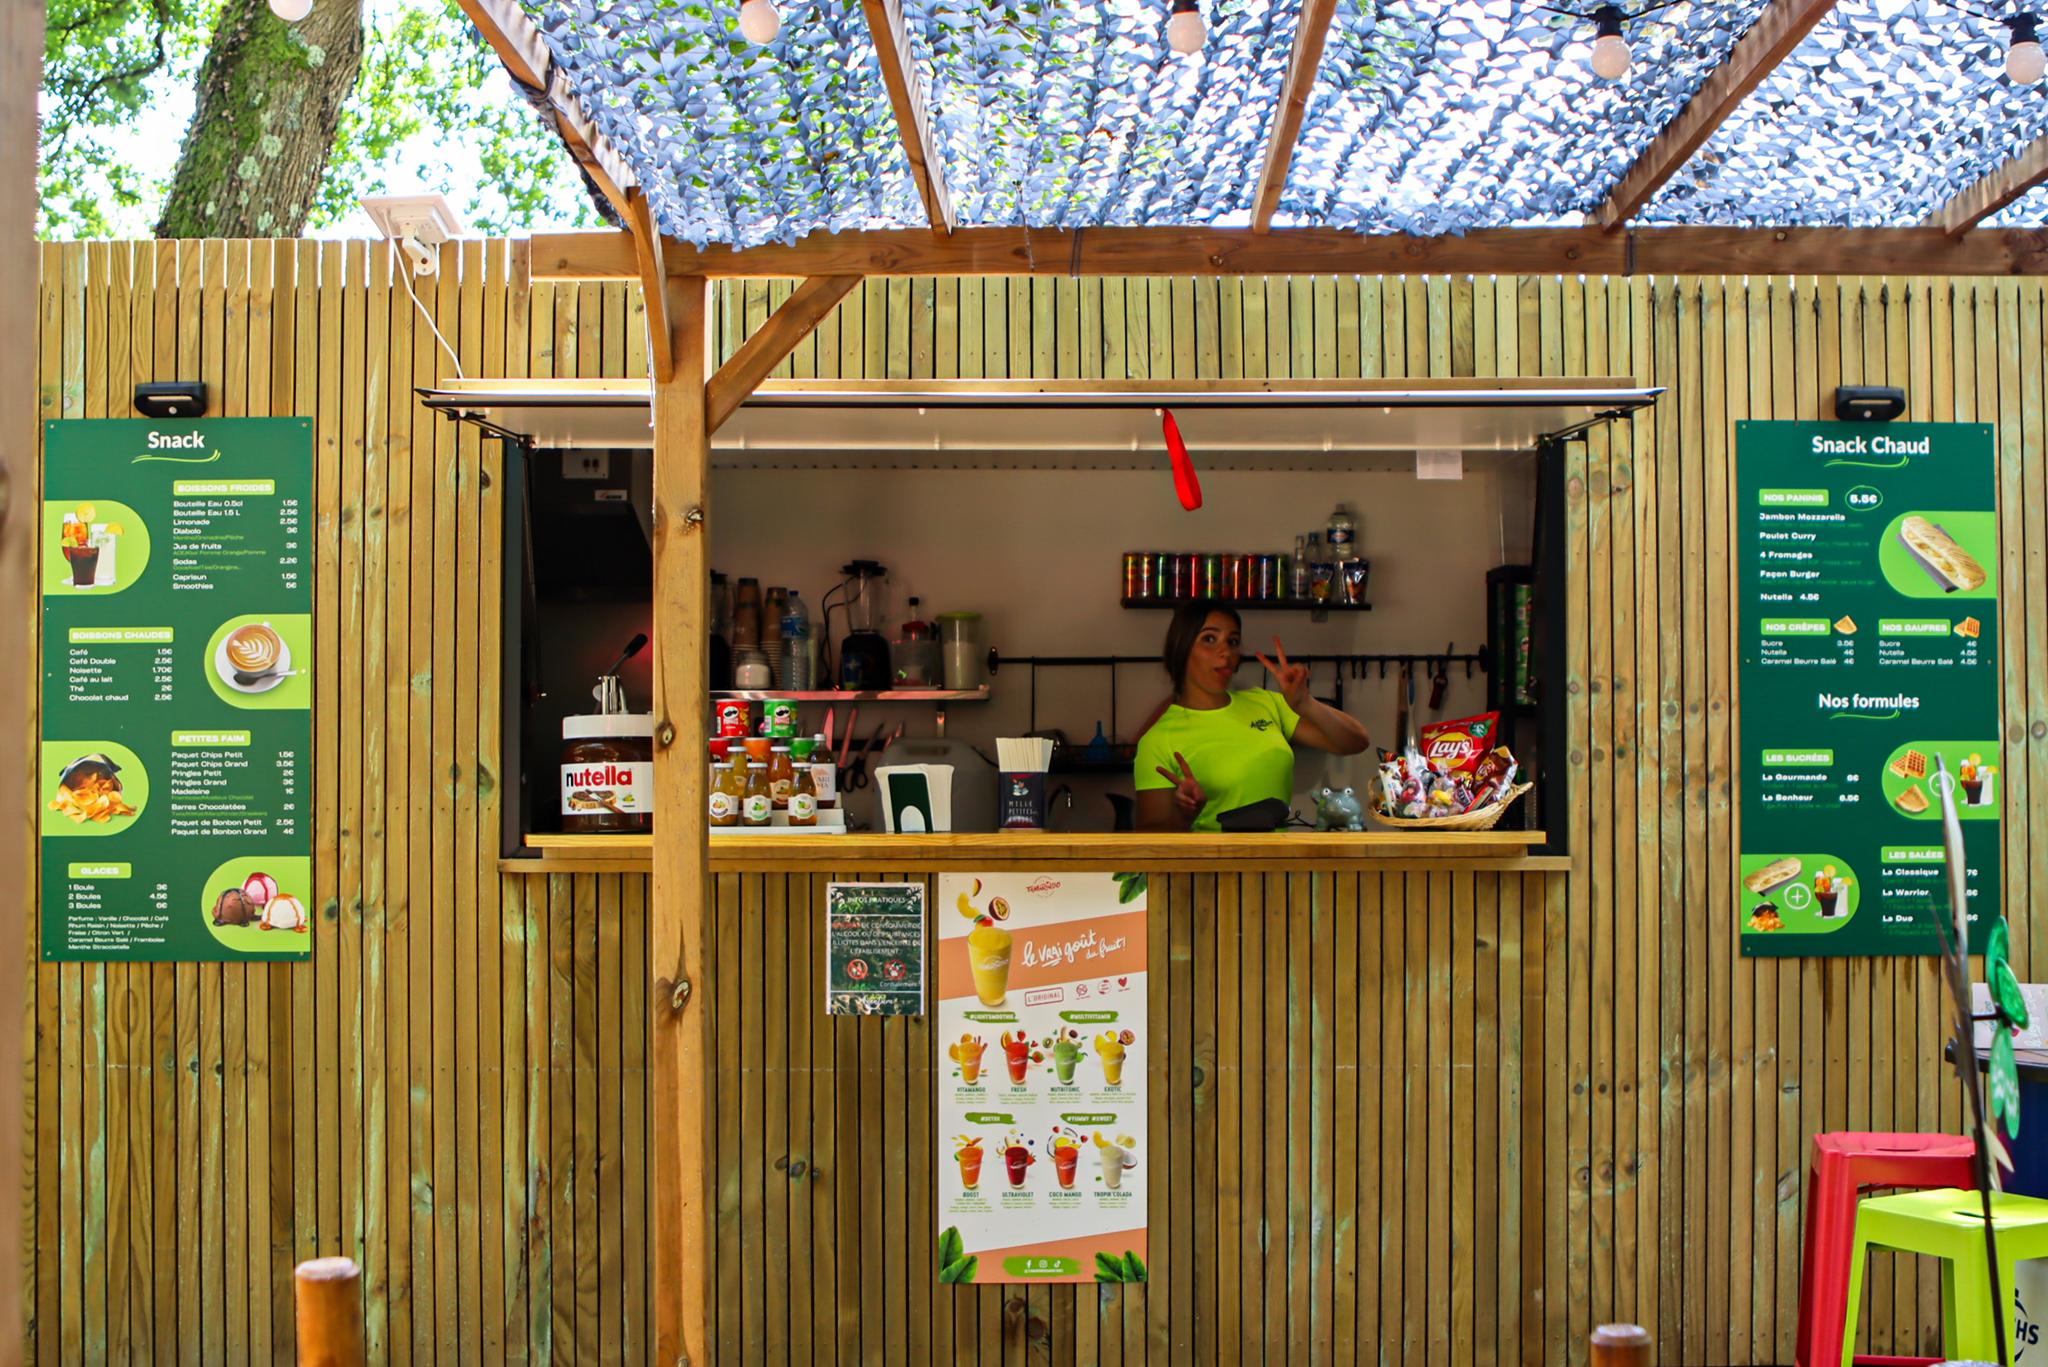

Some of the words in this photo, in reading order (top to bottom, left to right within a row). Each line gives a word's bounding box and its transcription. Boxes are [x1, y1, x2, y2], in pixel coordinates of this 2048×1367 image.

[148, 431, 205, 449] Snack
[1812, 435, 1867, 455] Snack
[1871, 436, 1930, 455] Chaud
[177, 484, 228, 492] BOISSONS
[230, 484, 272, 492] FROIDES
[1764, 494, 1784, 502] NOS
[1786, 494, 1824, 502] PANINIS
[1759, 512, 1795, 521] Jambon
[1798, 513, 1846, 521] Mozzarella
[1759, 532, 1789, 540] Poulet
[1791, 532, 1817, 541] Curry
[1760, 551, 1766, 559] 4
[1769, 551, 1813, 560] Fromages
[172, 574, 207, 582] Caprisun
[1760, 570, 1787, 579] Façon
[1790, 570, 1820, 579] Burger
[1760, 593, 1793, 601] Nutella
[1788, 622, 1826, 632] CRÊPES
[1881, 624, 1902, 632] NOS
[1904, 624, 1948, 632] GAUFRES
[72, 632, 122, 640] BOISSONS
[124, 631, 171, 639] CHAUDES
[1879, 640, 1901, 648] Sucre
[1879, 658, 1910, 666] Caramel
[1911, 658, 1936, 666] Beurre
[1818, 693, 1850, 709] Nos
[1852, 693, 1920, 709] formules
[179, 735, 219, 743] PETITES
[1429, 739, 1470, 759] Lay's
[200, 751, 223, 759] Chips
[1766, 754, 1784, 762] LES
[1785, 753, 1830, 762] SUCRÉES
[200, 760, 223, 768] Chips
[171, 770, 202, 778] Pringles
[565, 765, 633, 788] nutella
[1775, 773, 1827, 781] Gourmande
[171, 779, 202, 787] Pringles
[1775, 793, 1814, 801] Bonheur
[171, 819, 199, 827] Paquet
[171, 828, 199, 836] Paquet
[1888, 851, 1906, 859] LES
[1908, 850, 1944, 859] SALÉES
[80, 867, 119, 875] GLACES
[1895, 868, 1939, 877] Classique
[1021, 941, 1039, 967] le
[1064, 928, 1097, 963] goût
